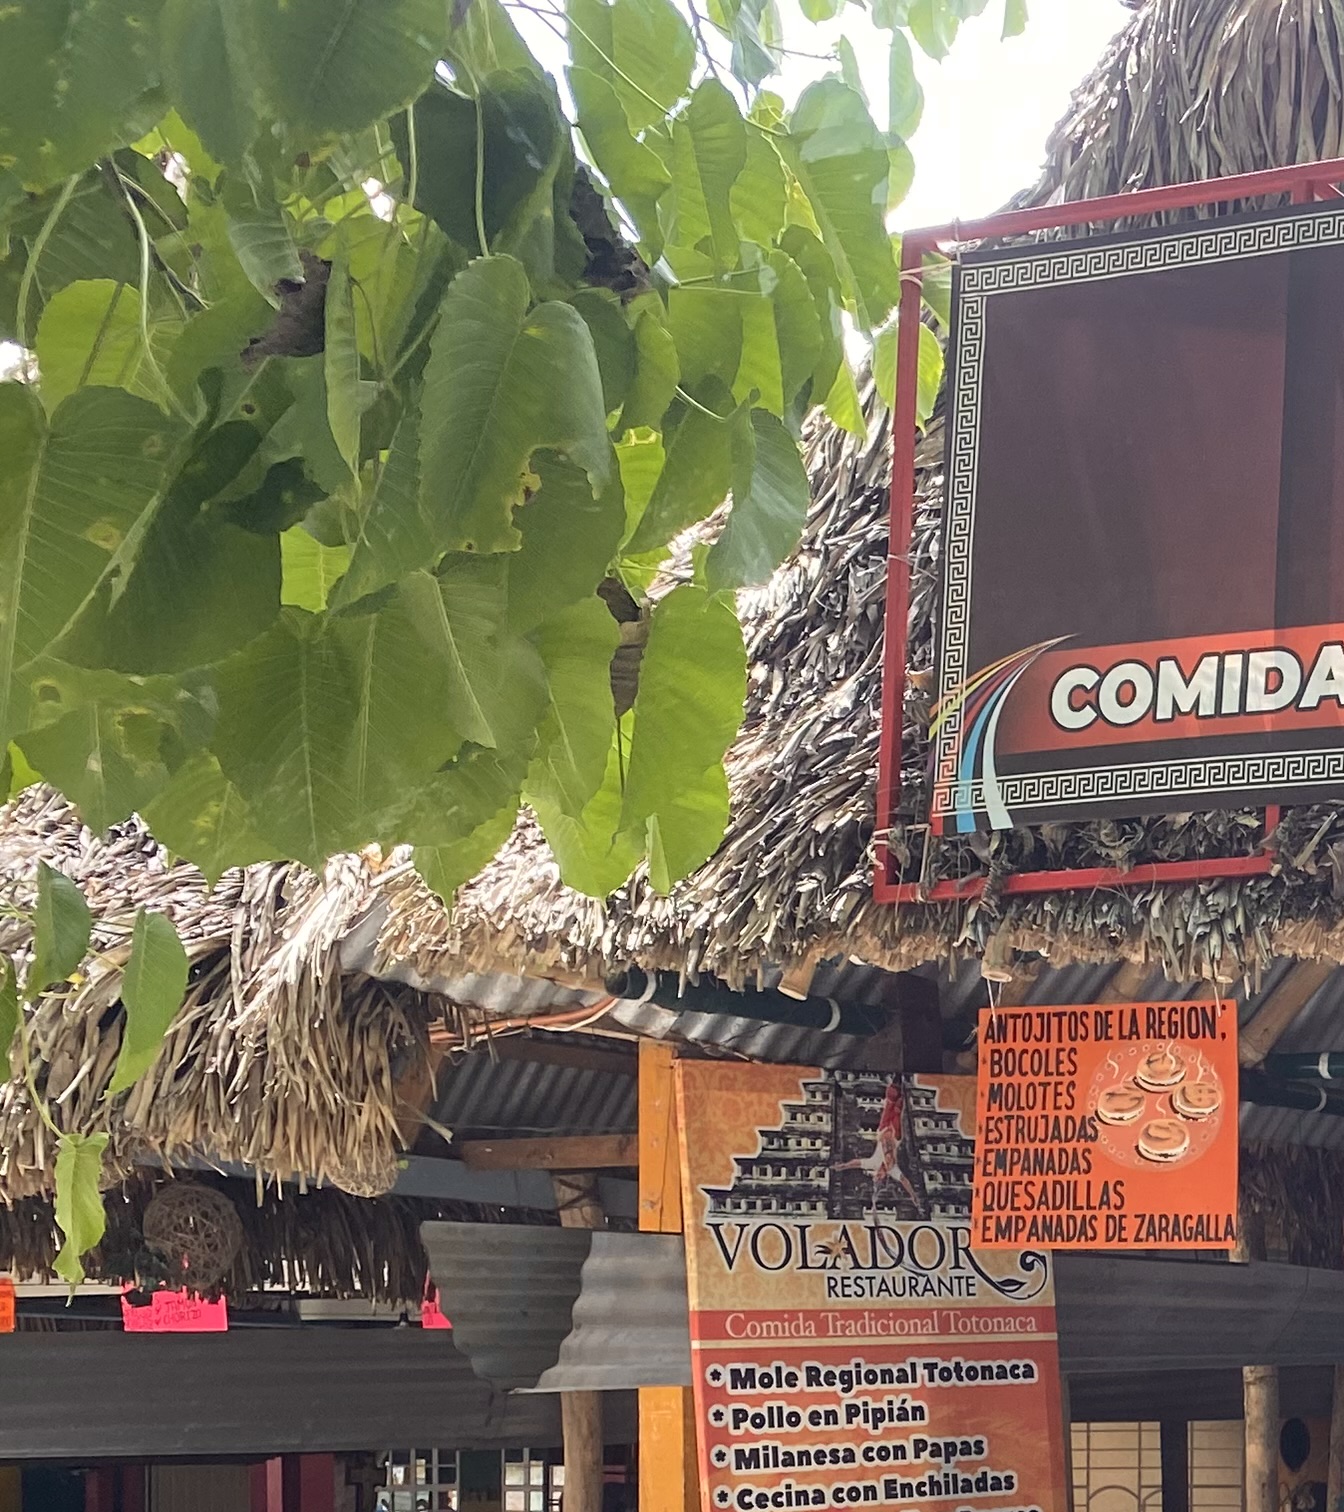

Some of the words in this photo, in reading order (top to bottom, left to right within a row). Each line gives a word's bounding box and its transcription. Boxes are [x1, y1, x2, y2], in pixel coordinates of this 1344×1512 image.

[984, 1011, 1088, 1043] ANTOJITOS
[1094, 1011, 1112, 1040] DE
[1118, 1009, 1140, 1040] LA
[990, 1048, 1078, 1077] BOCOLES
[987, 1081, 1075, 1112] MOLOTES
[984, 1115, 1098, 1144] ESTRUJADAS
[982, 1148, 1092, 1176] EMPANADAS
[983, 1181, 1124, 1211] QUESADILLAS
[982, 1215, 1097, 1242] EMPANADAS
[1106, 1214, 1126, 1242] DE
[1134, 1214, 1236, 1242] ZARAGALLA
[706, 1221, 1028, 1293] VOLADOR
[827, 1275, 977, 1298] RESTAURANTE
[725, 1314, 815, 1338] Comida
[821, 1309, 938, 1336] Tradicional
[943, 1311, 1037, 1334] Totonaca
[730, 1366, 799, 1390] Mole
[806, 1362, 917, 1392] Regional
[924, 1362, 1035, 1383] Totonaca
[733, 1406, 801, 1429] Pollo
[809, 1408, 838, 1426] en
[846, 1400, 925, 1429] Pipián
[735, 1445, 855, 1470] Milanesa
[863, 1441, 906, 1461] con
[914, 1437, 985, 1463] Papas
[737, 1484, 826, 1510] Cecina
[832, 1484, 878, 1502] con
[885, 1472, 1015, 1499] Enchiladas
